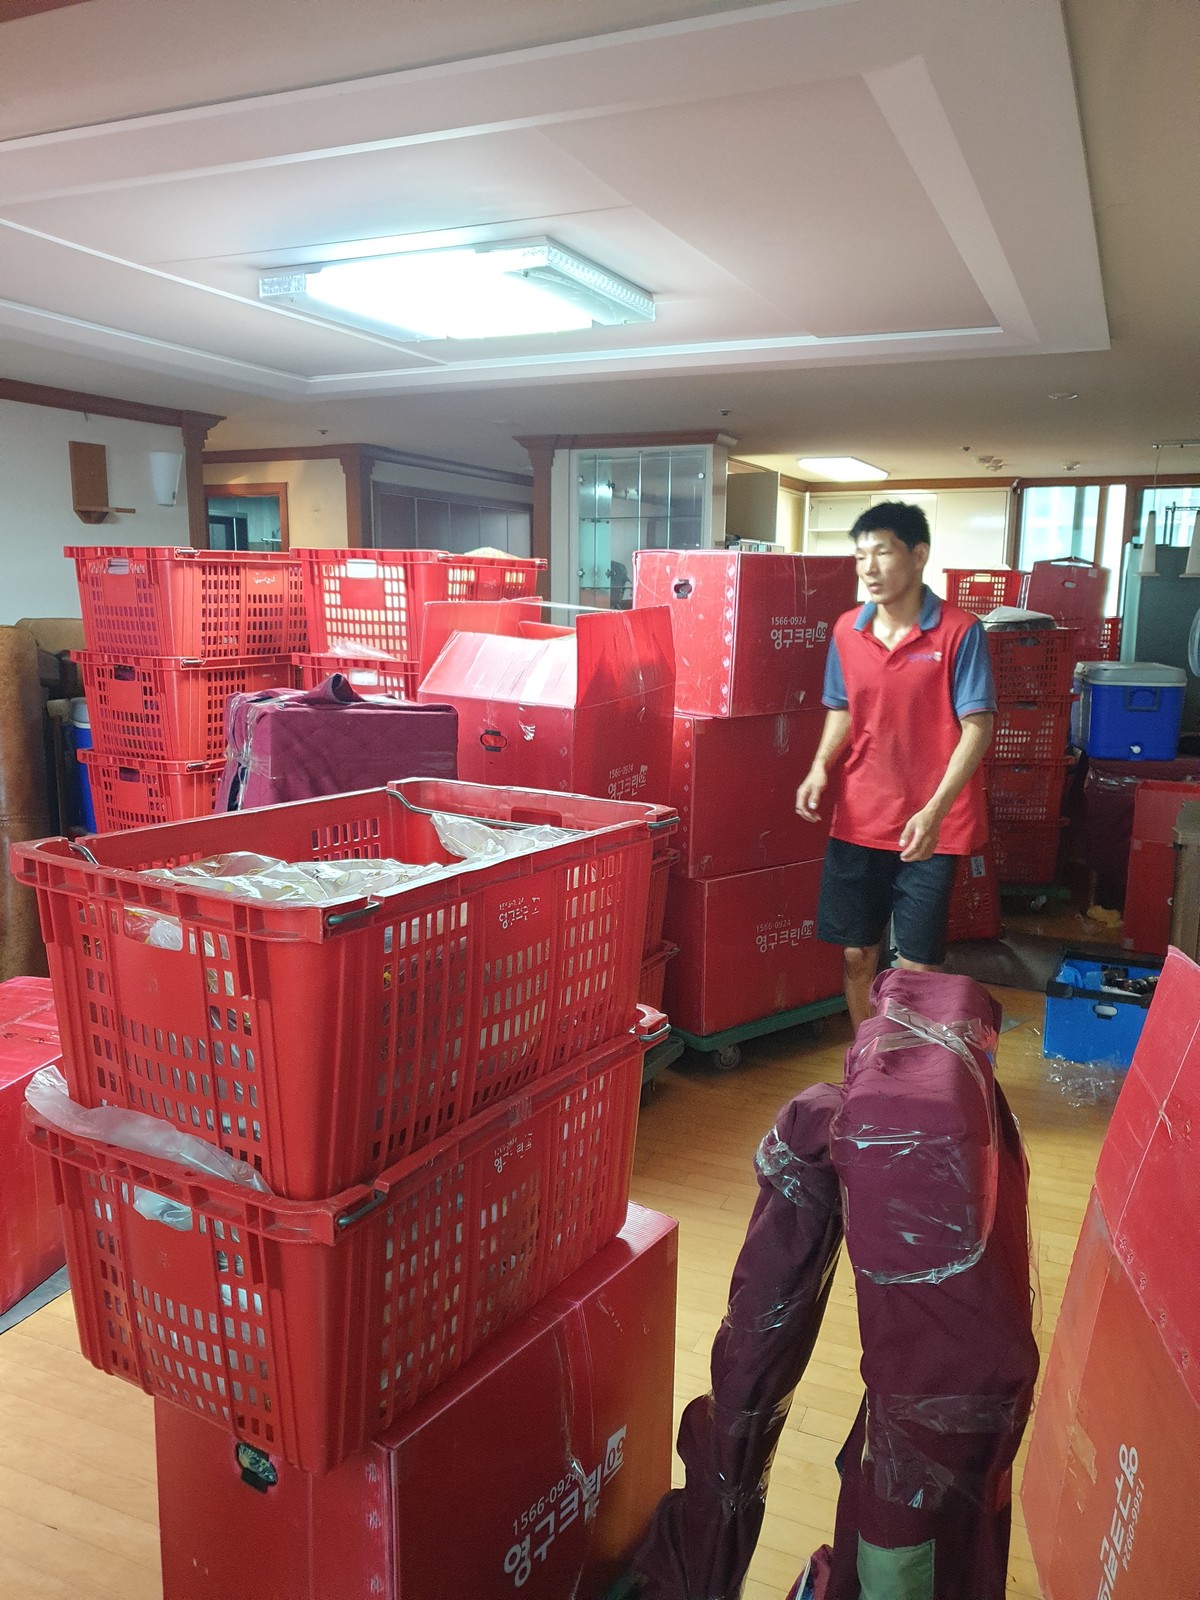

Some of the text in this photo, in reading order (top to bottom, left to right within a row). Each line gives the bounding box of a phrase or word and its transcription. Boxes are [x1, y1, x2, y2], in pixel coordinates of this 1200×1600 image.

[771, 616, 807, 626] 1566-0924
[770, 628, 816, 650] 영구크린
[756, 919, 791, 933] 1566-0924
[755, 927, 801, 953] 영구크린
[503, 1462, 602, 1588] 영구크린
[1099, 1443, 1139, 1591] 영구크린
[1121, 1477, 1145, 1572] 1566-0924
